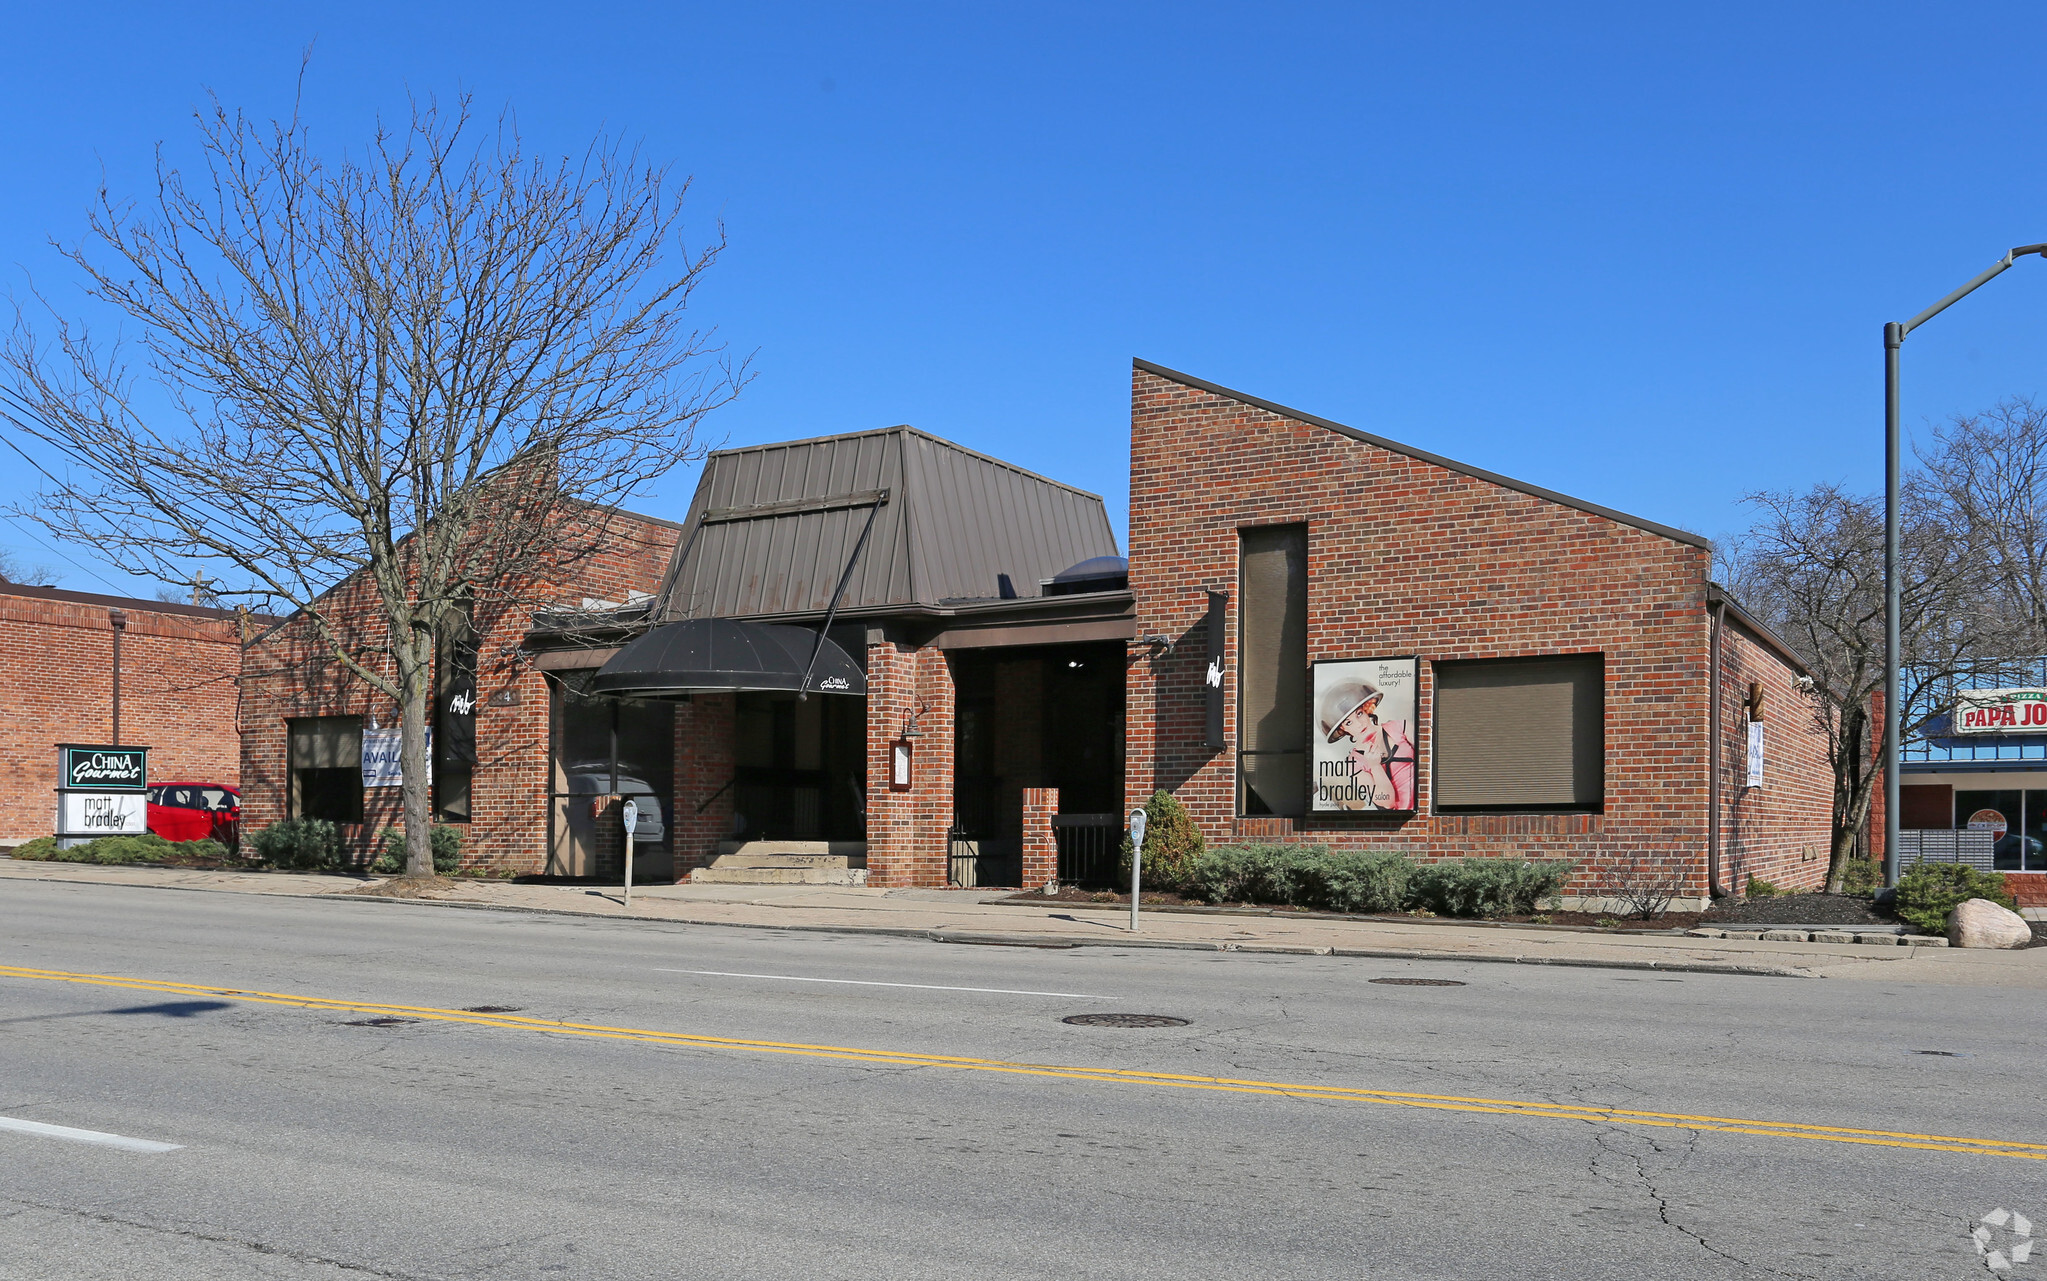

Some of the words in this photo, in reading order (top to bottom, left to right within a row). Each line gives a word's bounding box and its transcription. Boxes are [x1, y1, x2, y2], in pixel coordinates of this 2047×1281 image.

[1379, 670, 1412, 679] affordable
[1379, 679, 1401, 688] luxury!
[1965, 705, 2017, 727] PAPA
[92, 753, 132, 769] CHINA
[363, 751, 402, 763] AVAIL
[73, 761, 140, 783] Gourmet
[1320, 757, 1356, 777] matt
[1320, 777, 1376, 806] bradley
[1375, 792, 1390, 800] salon
[85, 796, 112, 810] matt
[84, 809, 126, 830] bradley
